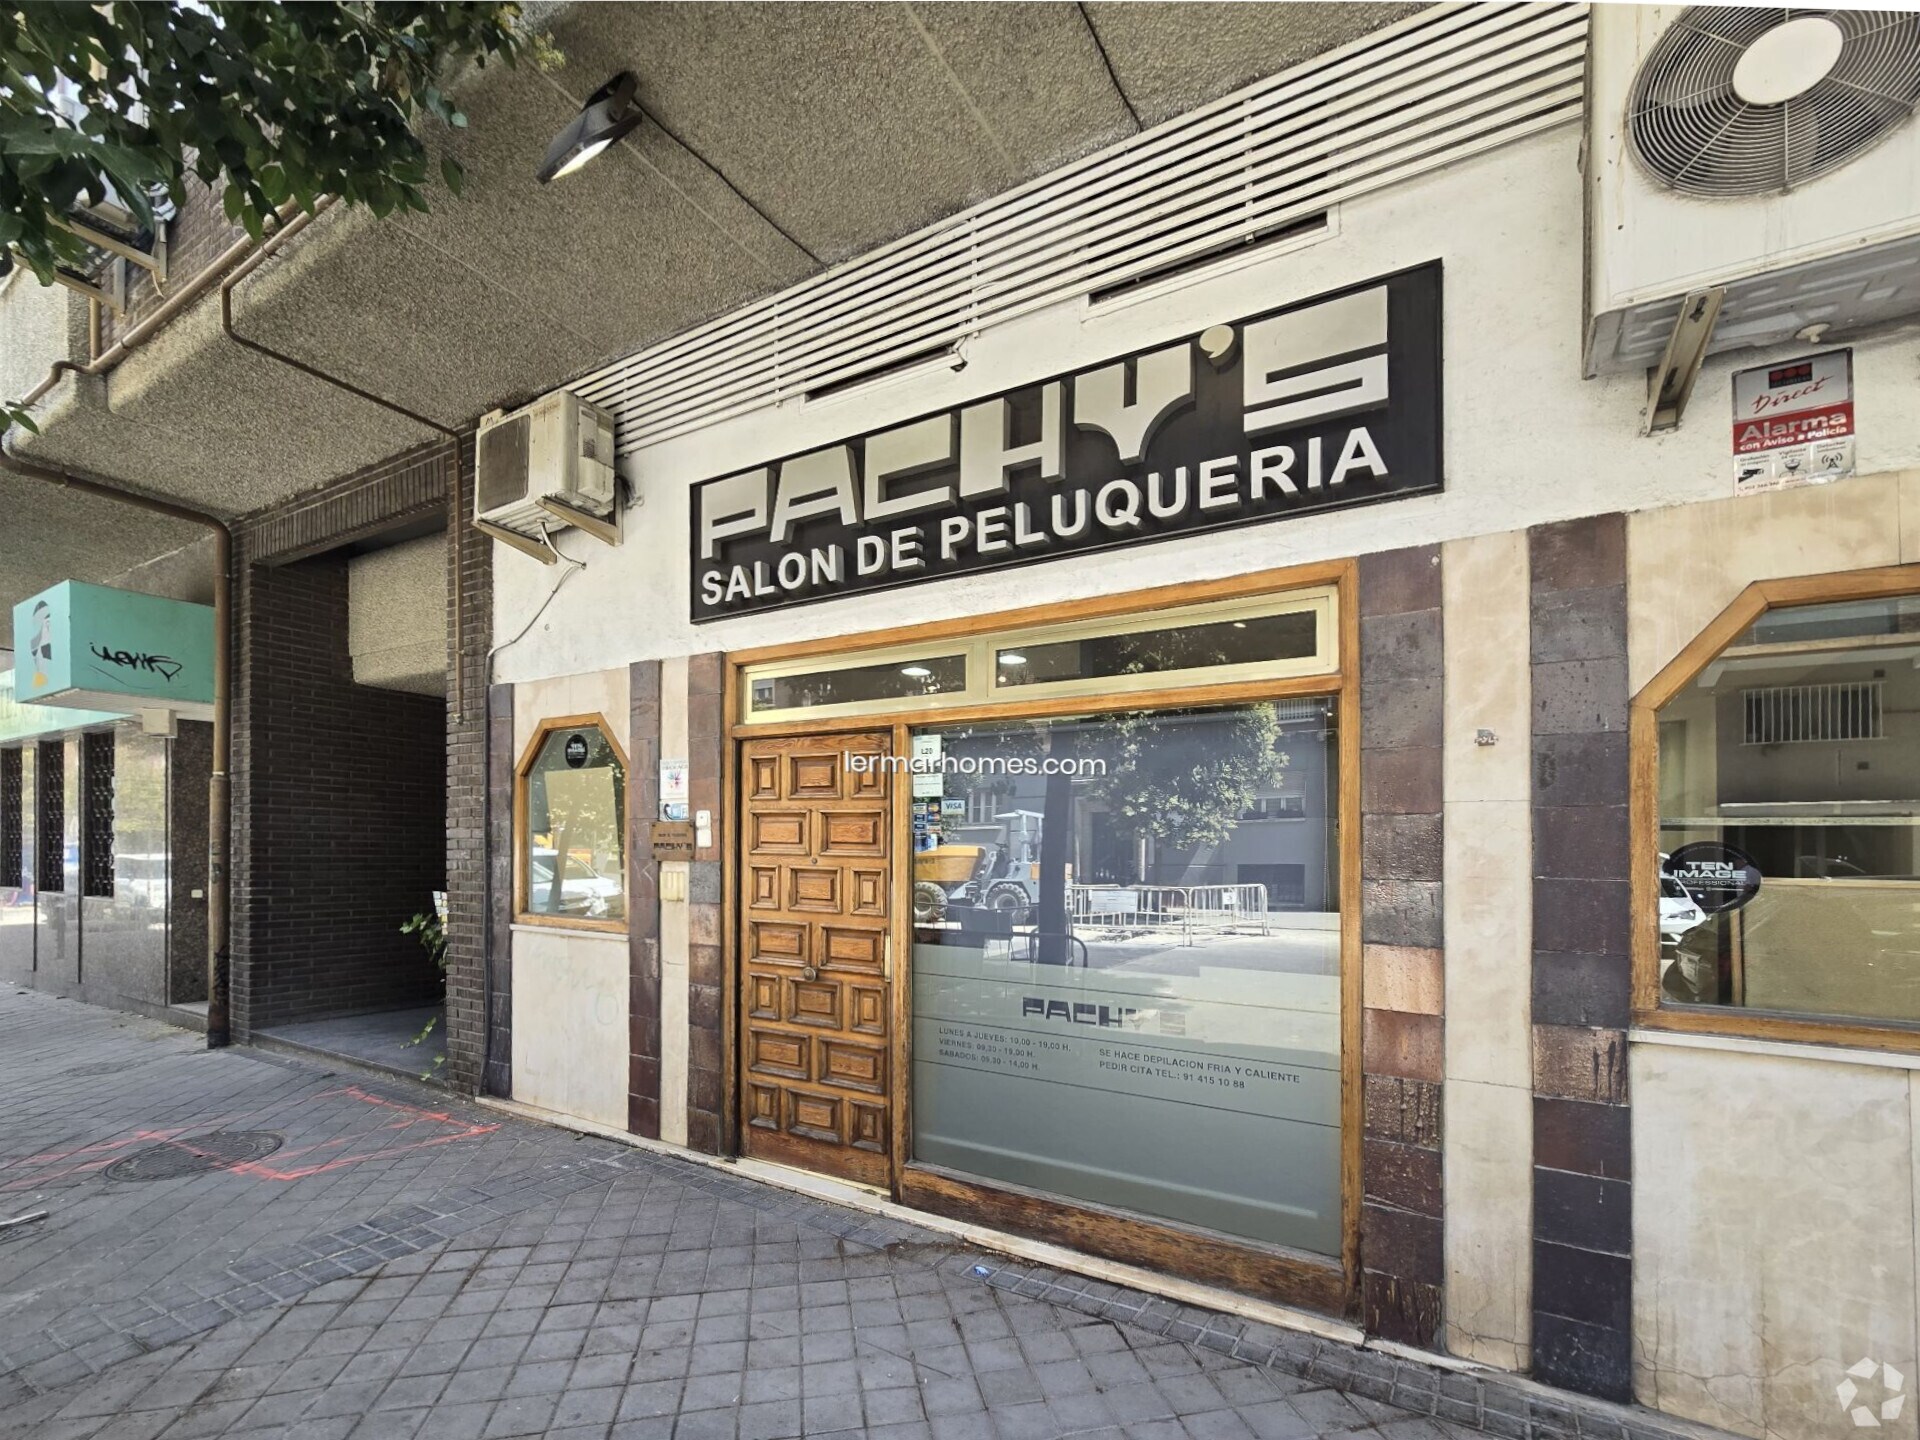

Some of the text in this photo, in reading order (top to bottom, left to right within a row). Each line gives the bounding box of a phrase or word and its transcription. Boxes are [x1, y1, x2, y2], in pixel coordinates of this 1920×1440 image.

[1752, 375, 1834, 414] Direct
[700, 284, 1389, 560] PACHY'S
[1740, 412, 1847, 442] Alarma
[1740, 441, 1760, 451] con
[1763, 434, 1795, 447] Aviso
[1807, 425, 1847, 440] Policía
[700, 427, 1388, 606] SALON DE PELUQUERIA
[1674, 870, 1746, 878] IMAGE
[1686, 862, 1733, 870] TEN
[939, 1027, 964, 1037] LUNES
[974, 1033, 1008, 1043] JUEVES:
[1099, 1049, 1300, 1084] SE HACE DEPILACION FRIA Y CALIENTE
[1100, 1061, 1245, 1089] PEDIR CITA TEL.: 91 415 10 88
